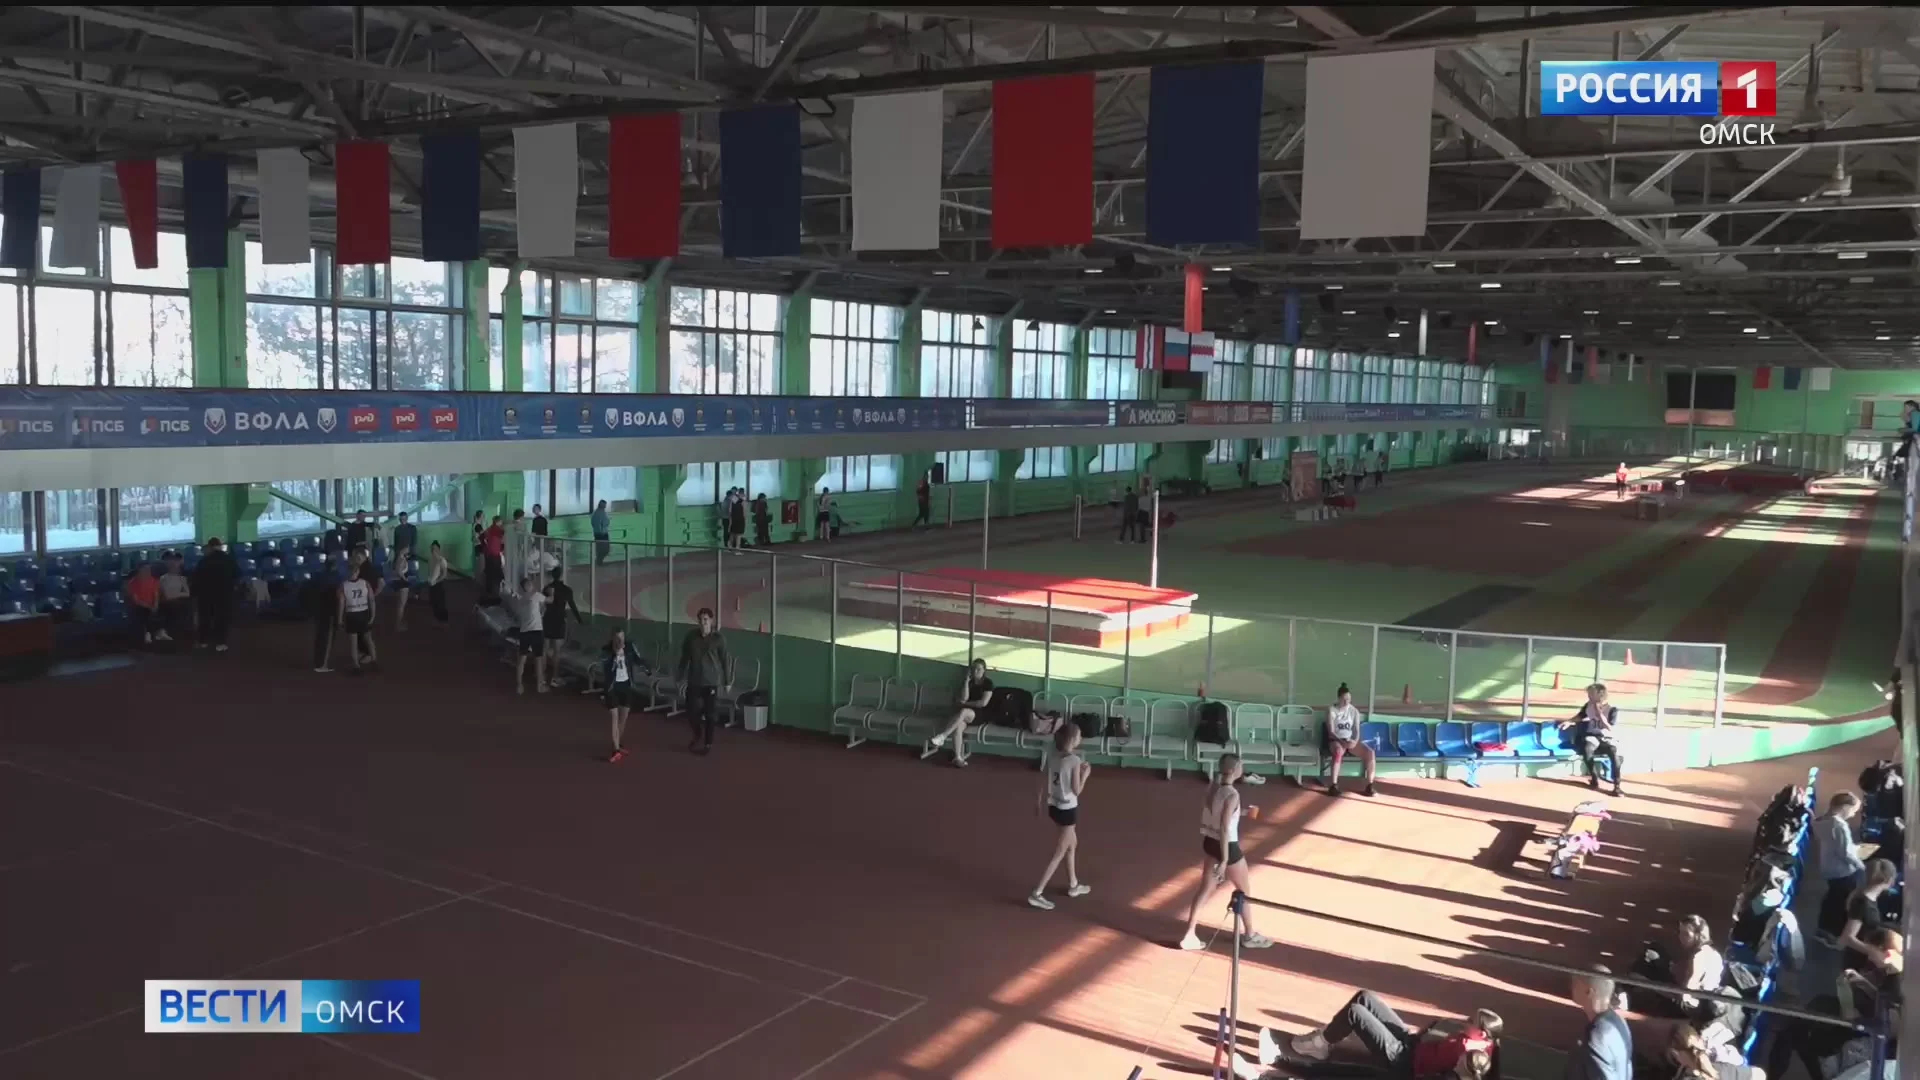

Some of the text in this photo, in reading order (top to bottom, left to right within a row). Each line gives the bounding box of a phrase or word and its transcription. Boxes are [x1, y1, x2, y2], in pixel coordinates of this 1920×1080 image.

[235, 412, 309, 431] ВФЛА
[622, 407, 668, 426] ВФЛА
[864, 412, 896, 423] ВФЛА
[1138, 409, 1176, 424] РОССИЮ
[19, 420, 53, 433] ПСБ
[92, 420, 125, 433] ПСБ
[160, 420, 190, 432] ПСБ
